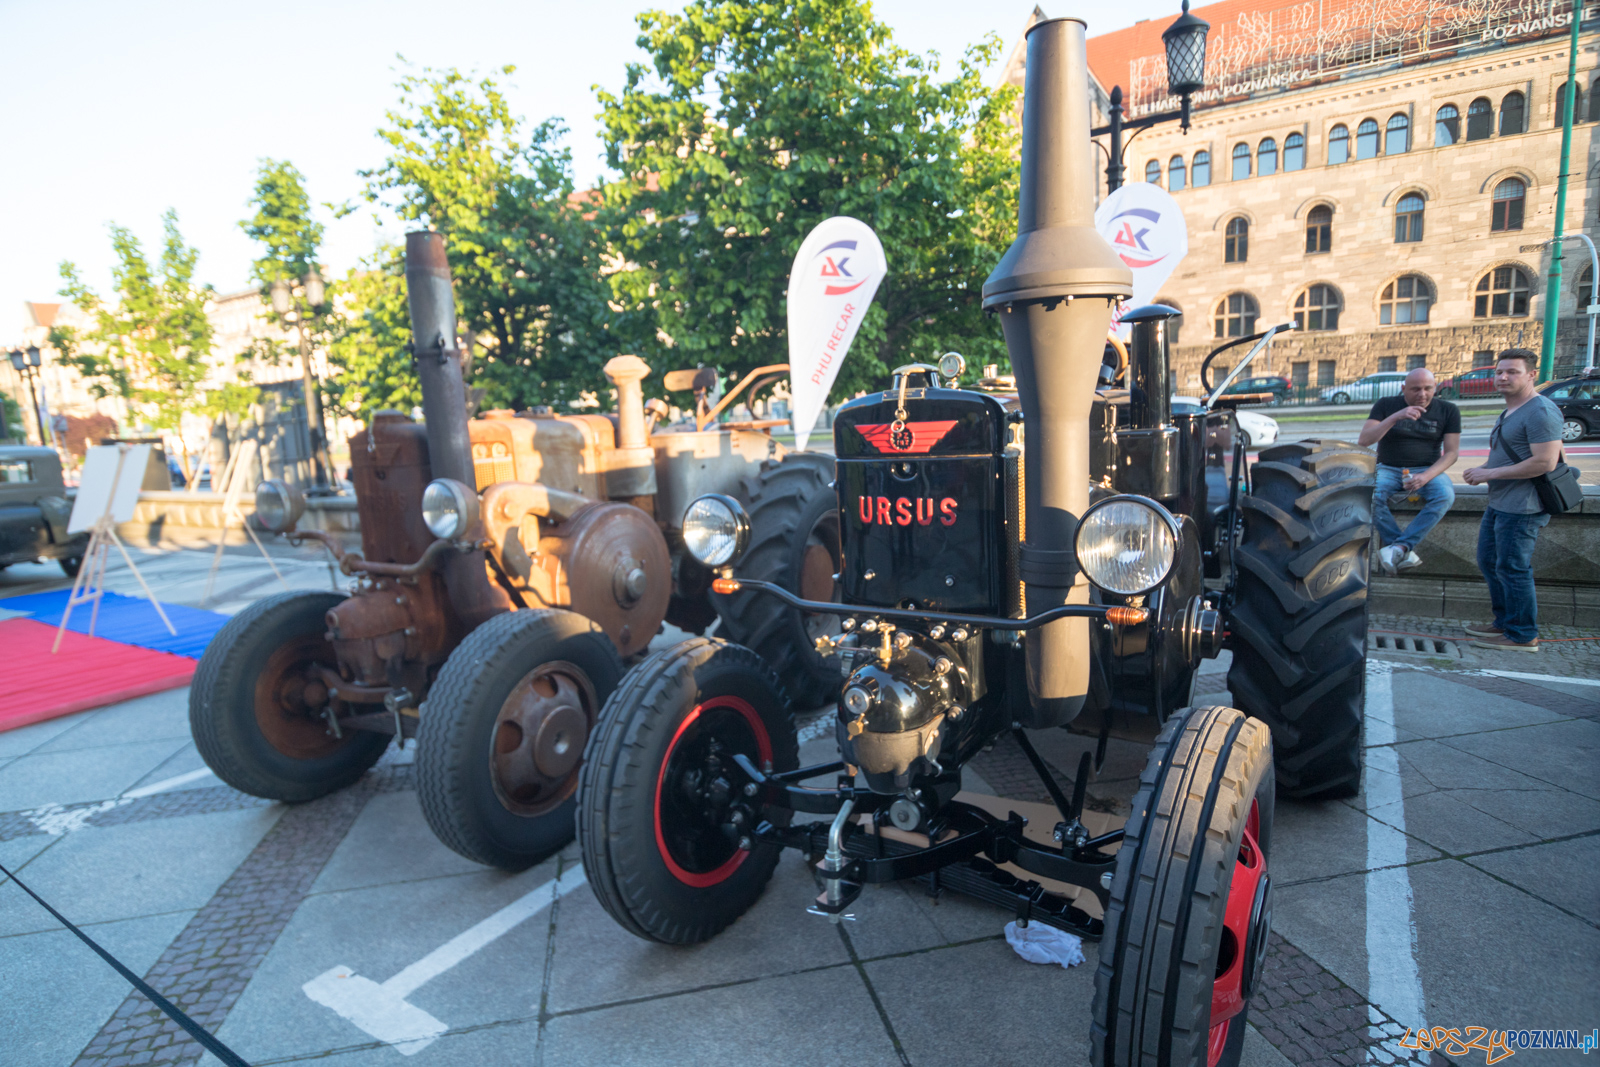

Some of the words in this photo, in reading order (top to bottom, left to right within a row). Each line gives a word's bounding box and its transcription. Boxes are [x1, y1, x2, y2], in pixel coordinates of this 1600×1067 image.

[1133, 89, 1221, 117] FILHARONIA
[811, 352, 833, 385] PHU
[827, 303, 856, 351] RECAR
[859, 495, 958, 527] URSUS
